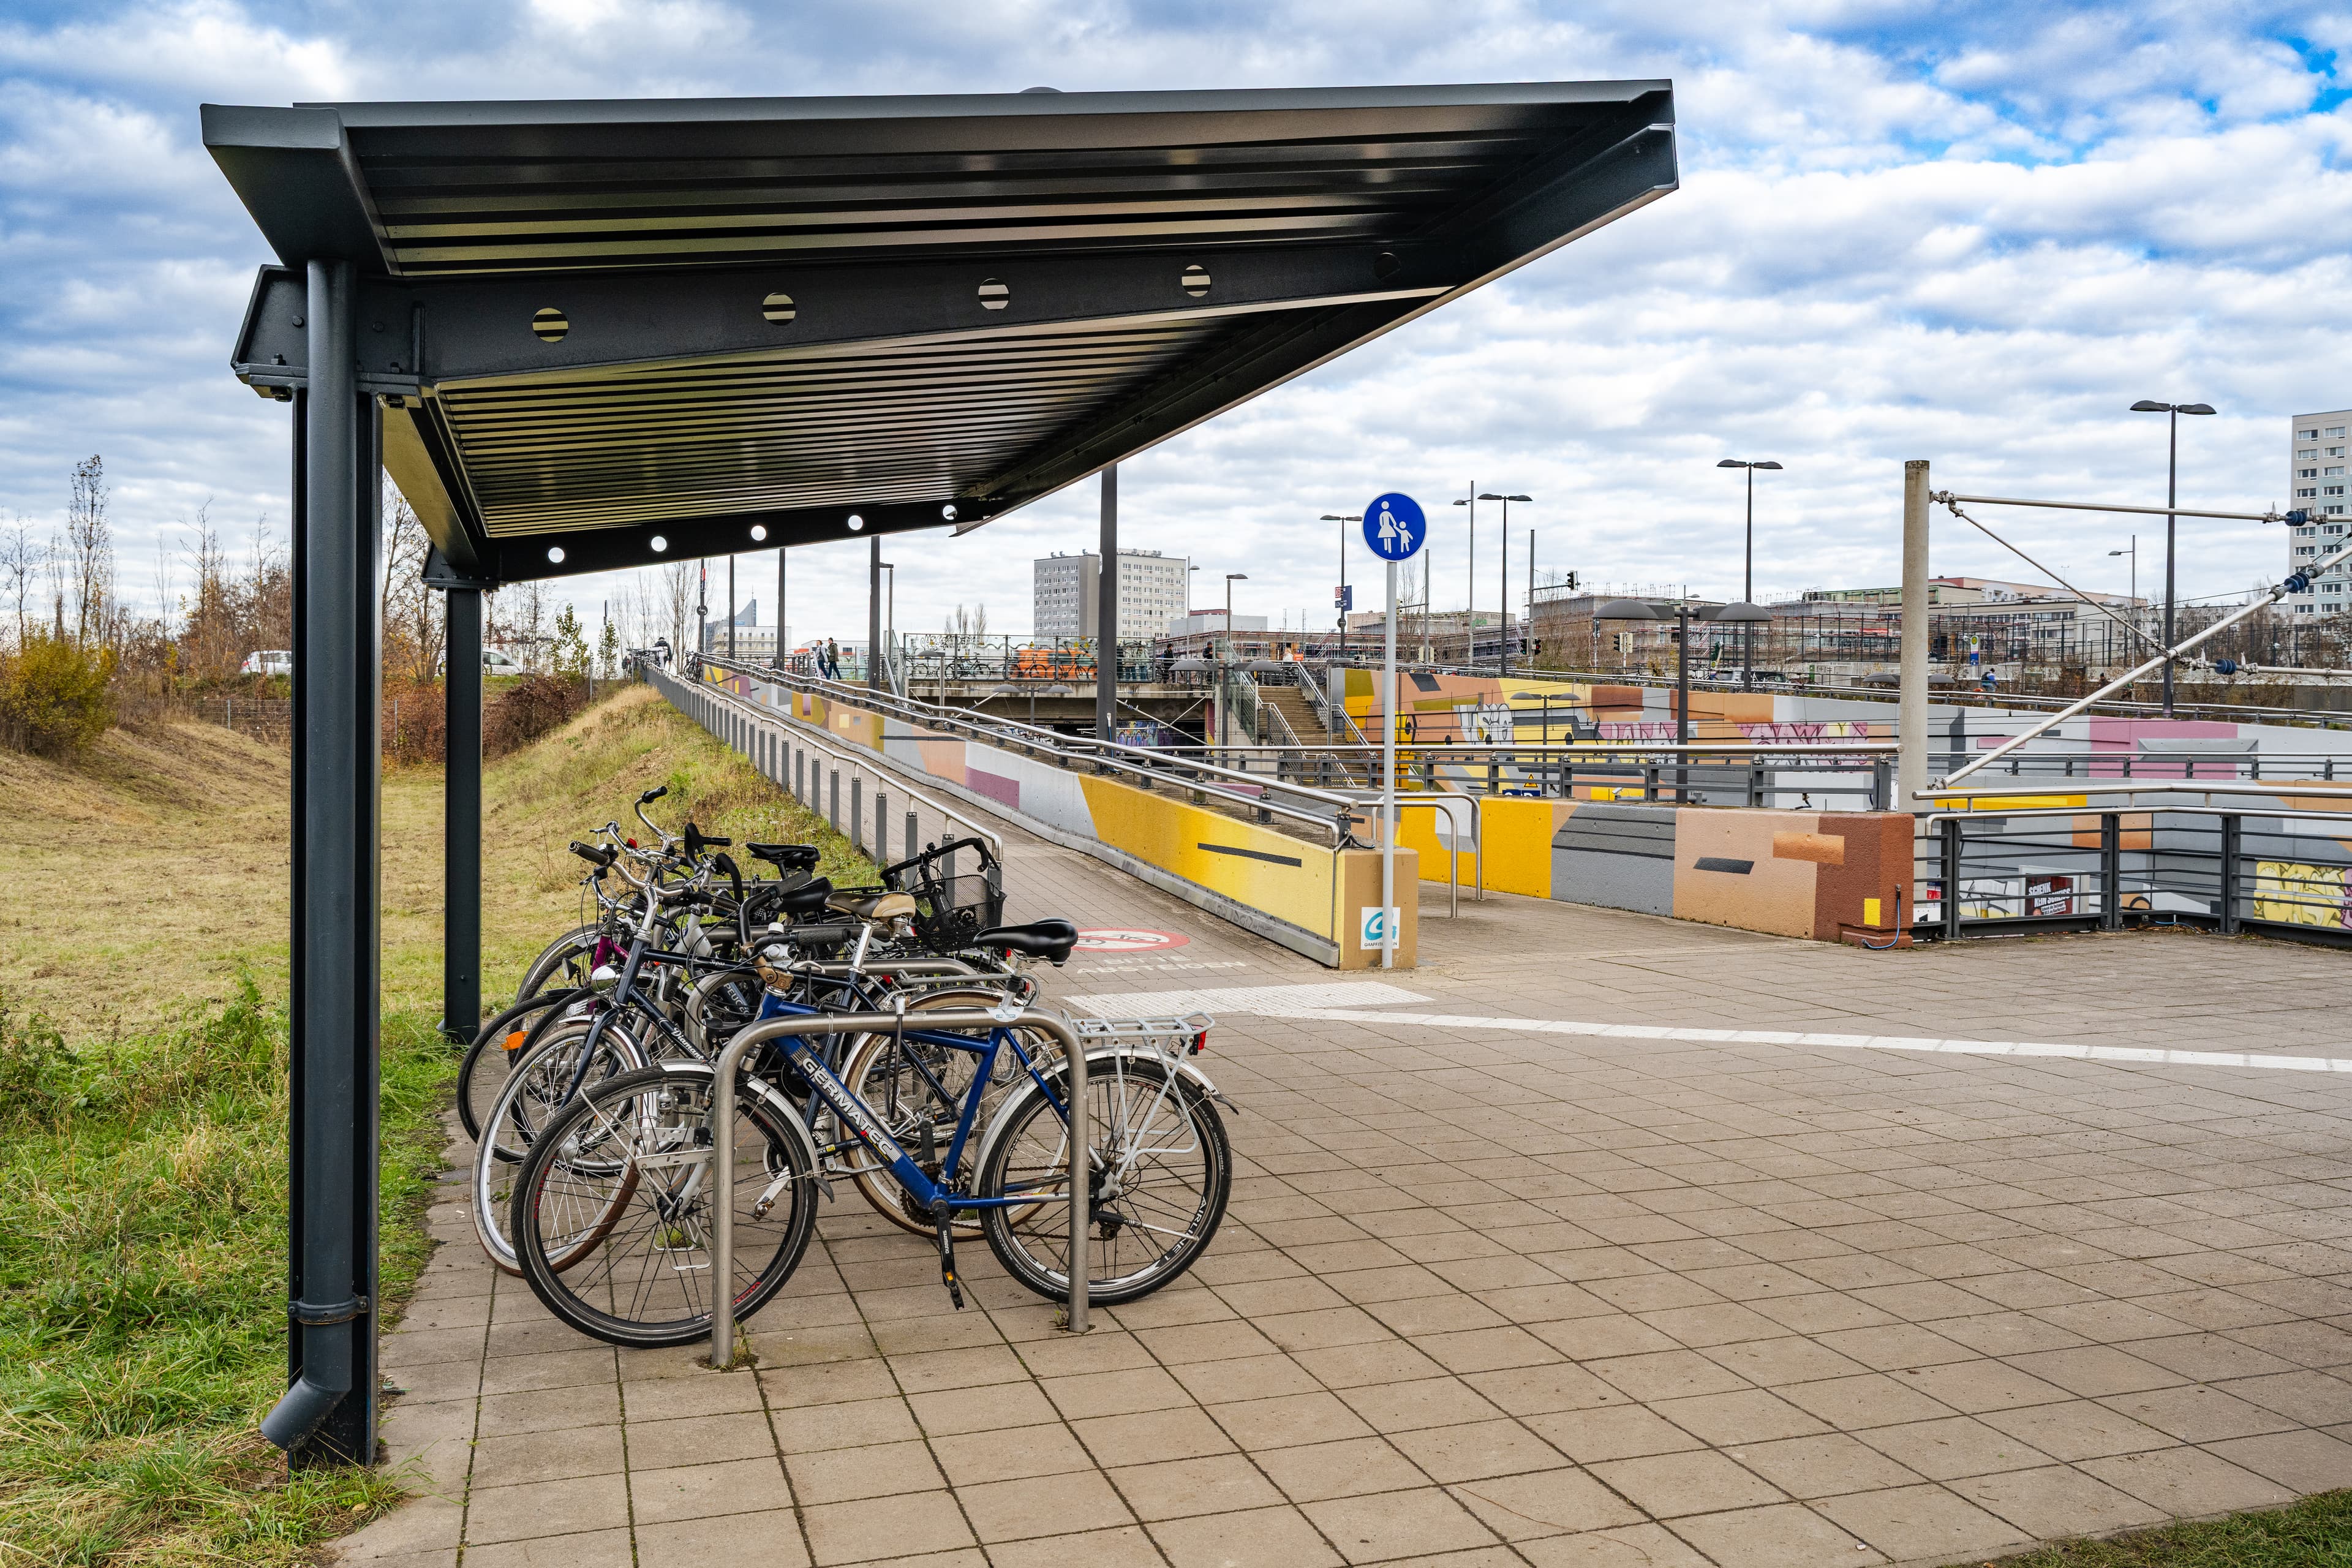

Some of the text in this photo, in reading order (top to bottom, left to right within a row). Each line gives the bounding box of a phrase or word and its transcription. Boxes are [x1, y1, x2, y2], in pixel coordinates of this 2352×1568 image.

[2029, 882, 2051, 895] SCHENK
[1077, 961, 1246, 974] ABSTEIGEN
[1104, 956, 1191, 965] BITTE
[723, 983, 750, 1017] PEUGEO
[671, 1027, 704, 1060] Diamant
[802, 1057, 892, 1155] GERMATEC
[1214, 1132, 1224, 1170] MARATHON
[1172, 1196, 1207, 1254] AIRLINE
